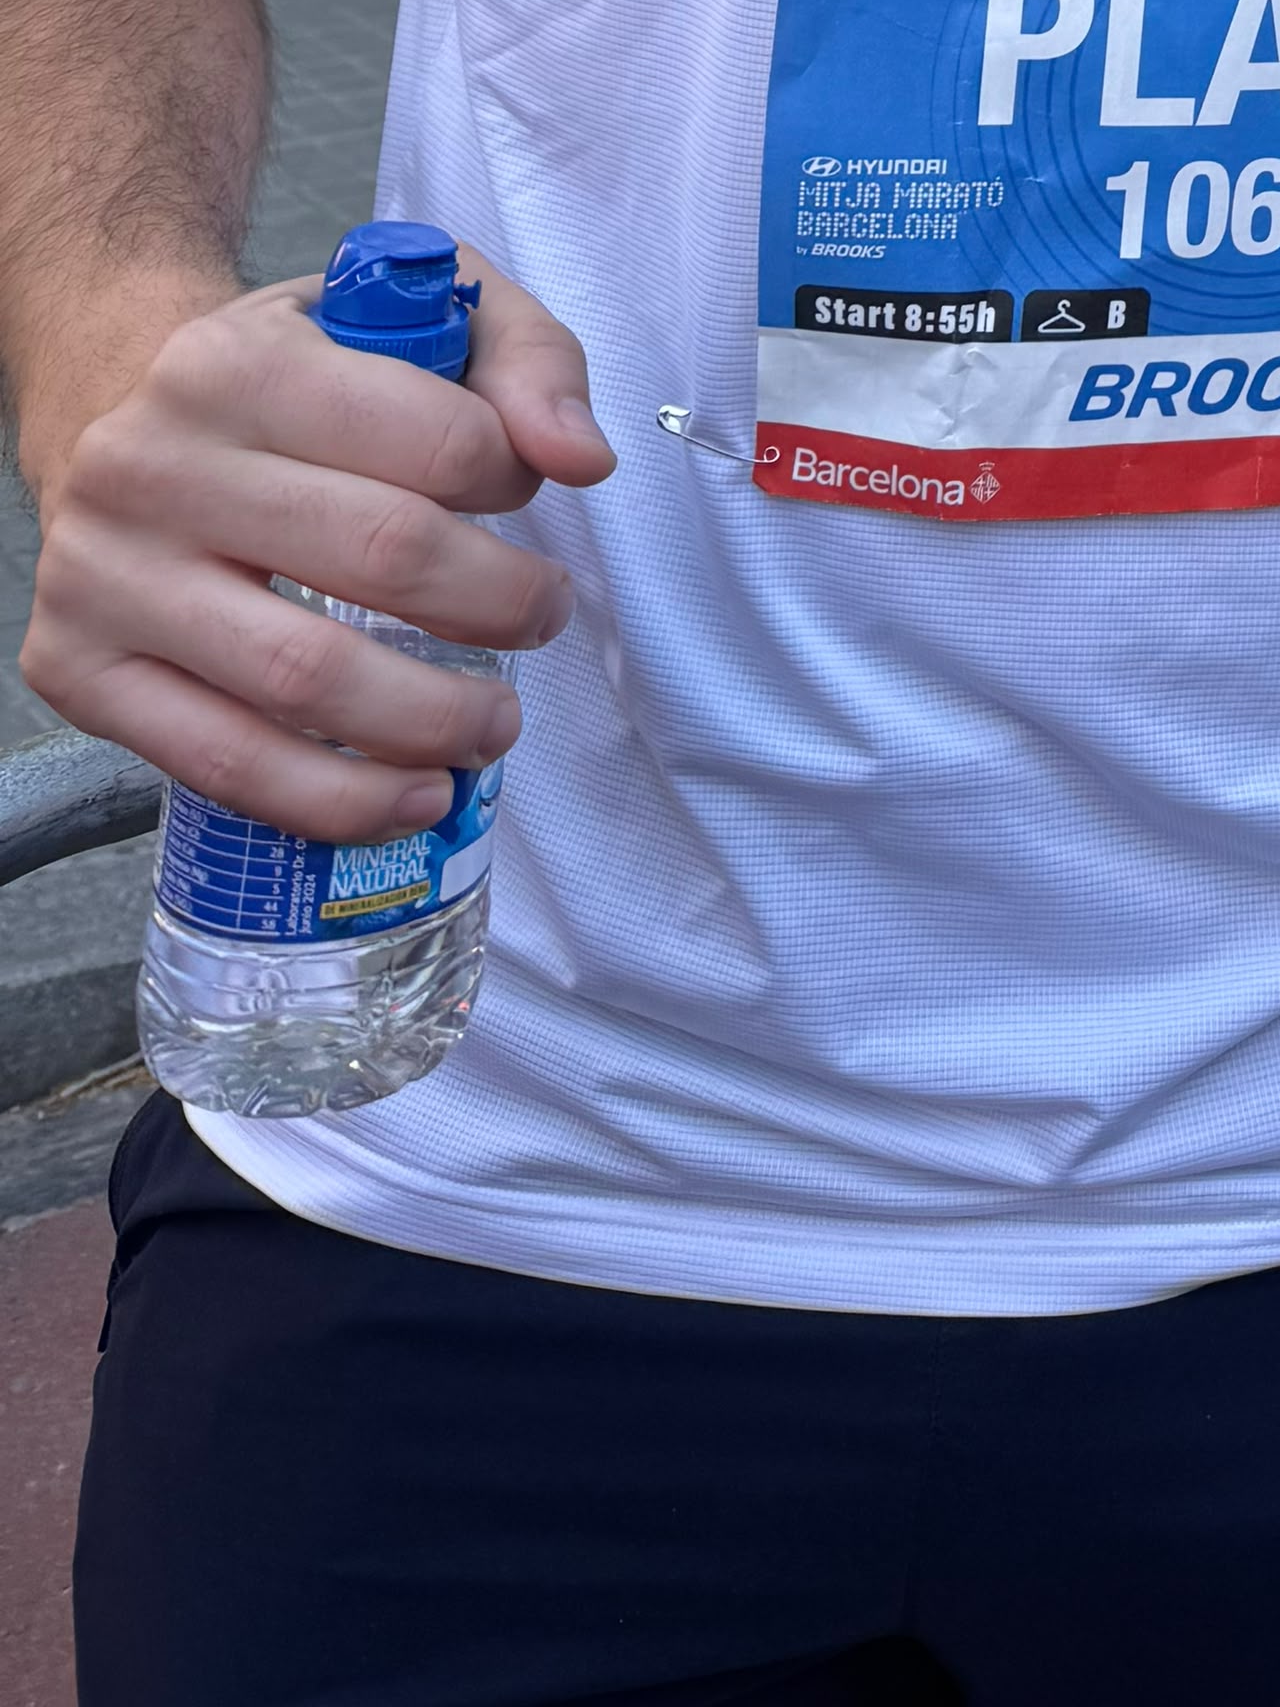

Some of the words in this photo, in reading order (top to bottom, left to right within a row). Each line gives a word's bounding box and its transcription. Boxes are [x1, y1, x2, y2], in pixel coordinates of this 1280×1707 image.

[847, 159, 947, 175] HYUNDAI
[799, 181, 881, 208] MITJA
[893, 176, 1004, 209] MARATÓ
[797, 211, 957, 239] BARCELONA
[811, 243, 887, 258] BROOKS
[814, 296, 896, 330] Start
[904, 301, 995, 334] 8:55h
[1107, 300, 1127, 330] B
[791, 446, 965, 506] Barcelona
[332, 830, 432, 874] MINERAL
[328, 857, 430, 900] NATURAL
